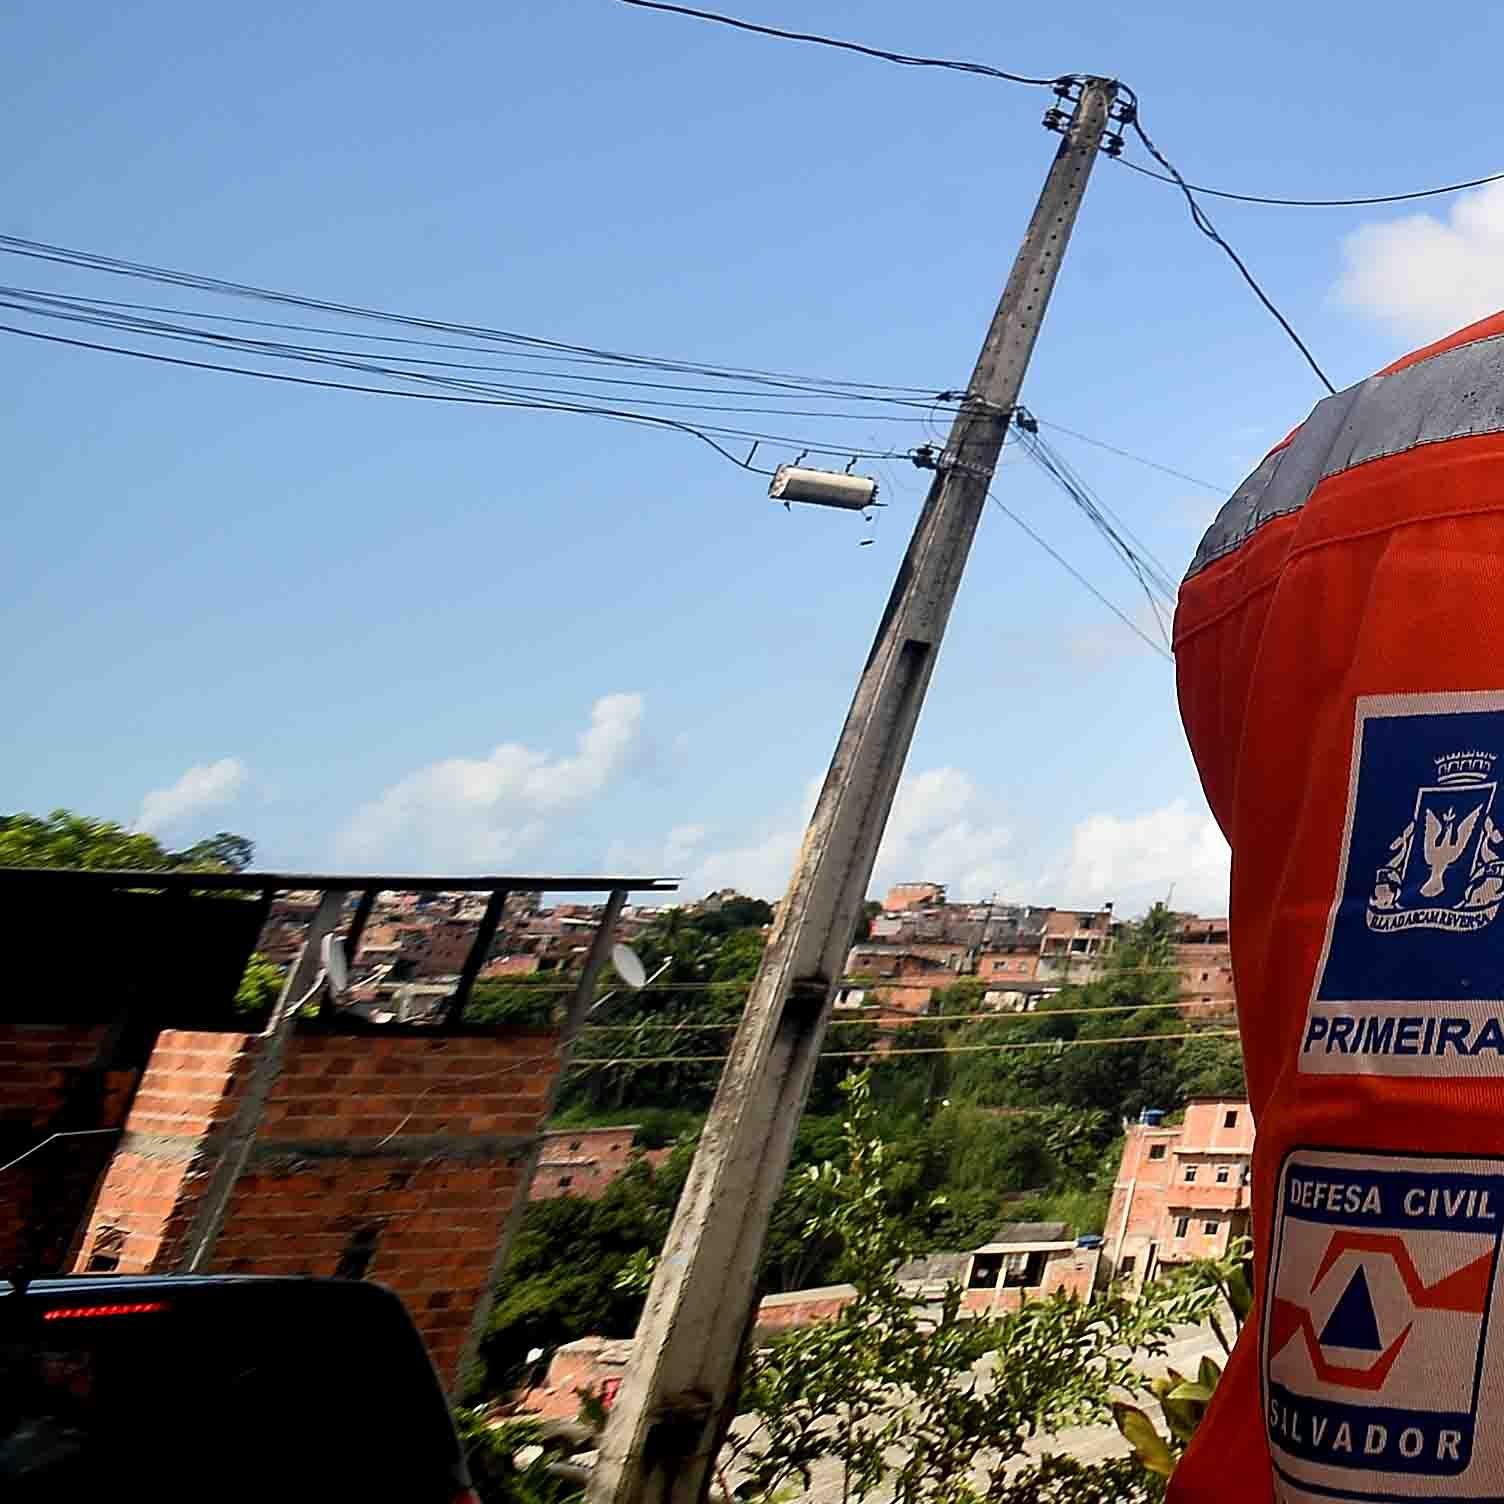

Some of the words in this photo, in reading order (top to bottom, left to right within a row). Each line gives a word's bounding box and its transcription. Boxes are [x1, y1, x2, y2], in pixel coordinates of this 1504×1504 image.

[1290, 1178, 1382, 1214] DEFESA
[1403, 1187, 1497, 1219] CIVIL
[1269, 1398, 1463, 1461] SALVADOR
